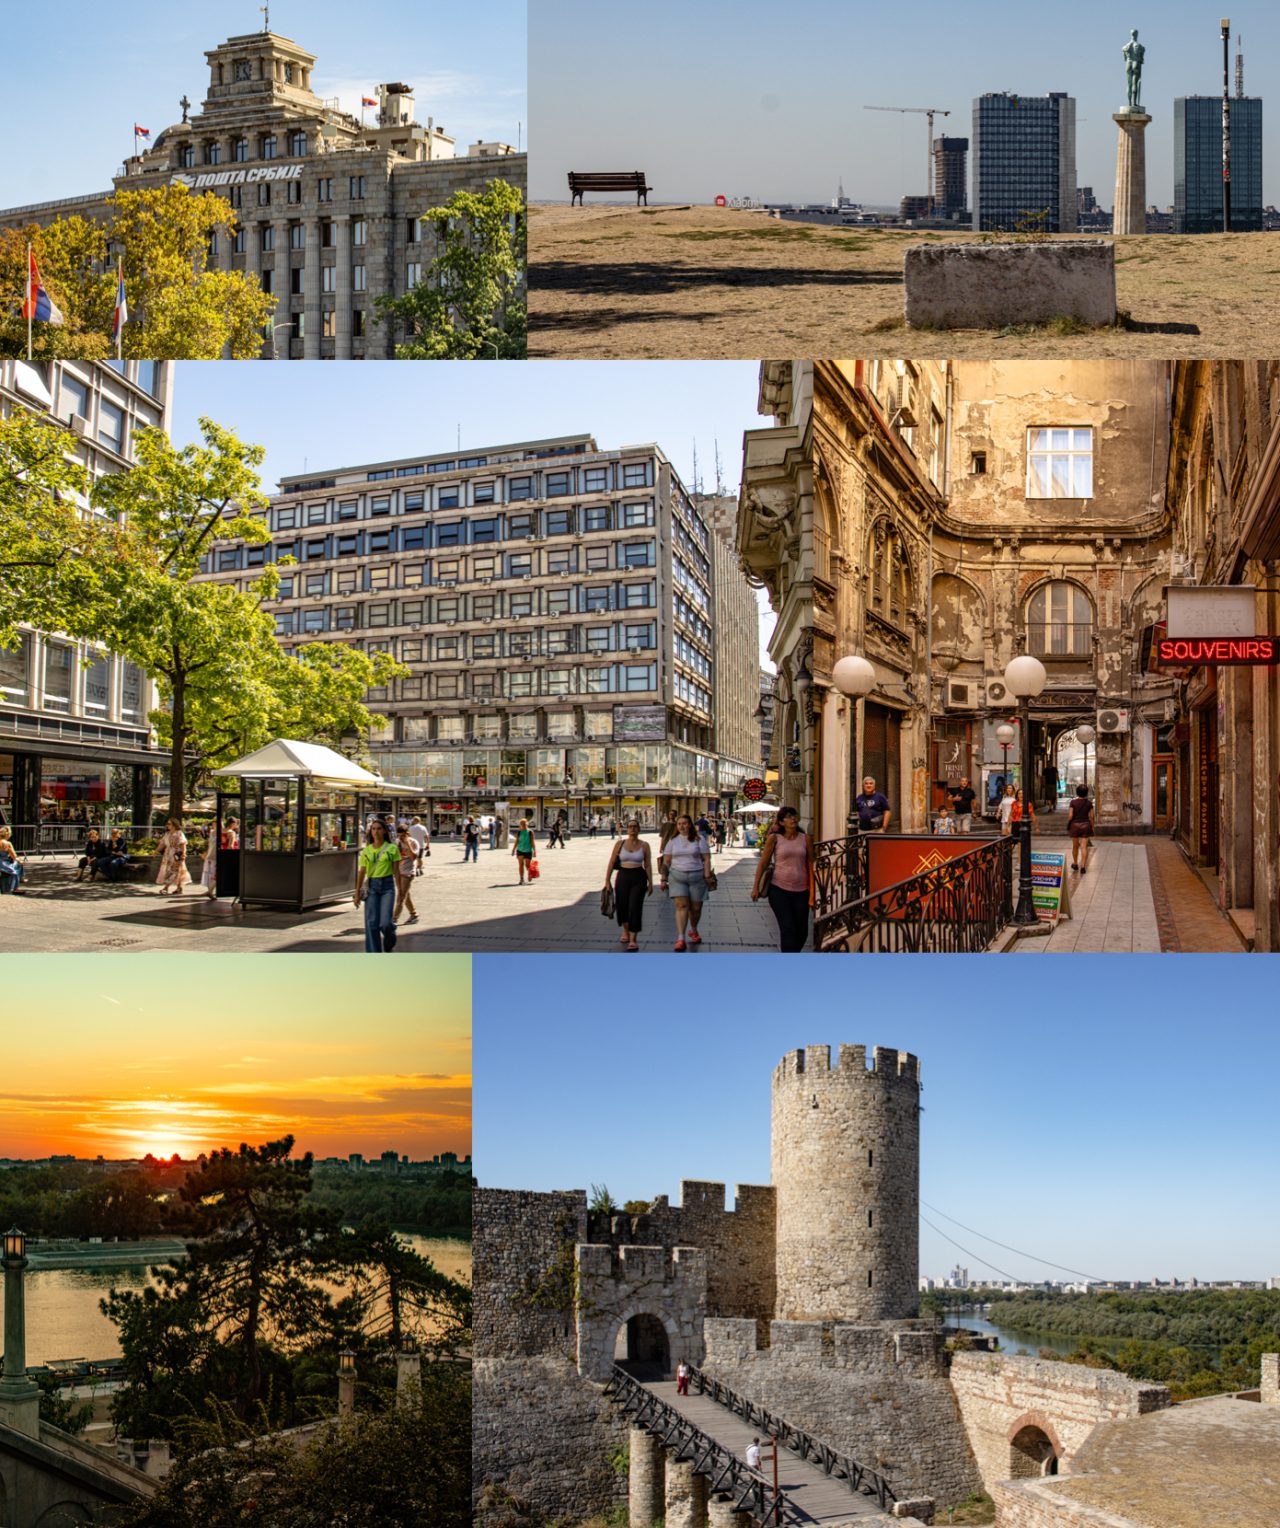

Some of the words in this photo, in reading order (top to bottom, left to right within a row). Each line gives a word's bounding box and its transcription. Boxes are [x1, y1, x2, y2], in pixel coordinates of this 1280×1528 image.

[195, 170, 247, 187] ПОШТА
[246, 165, 304, 182] СРБИЈЕ
[1160, 641, 1273, 659] SOUVENIRS
[945, 764, 963, 772] IRISH
